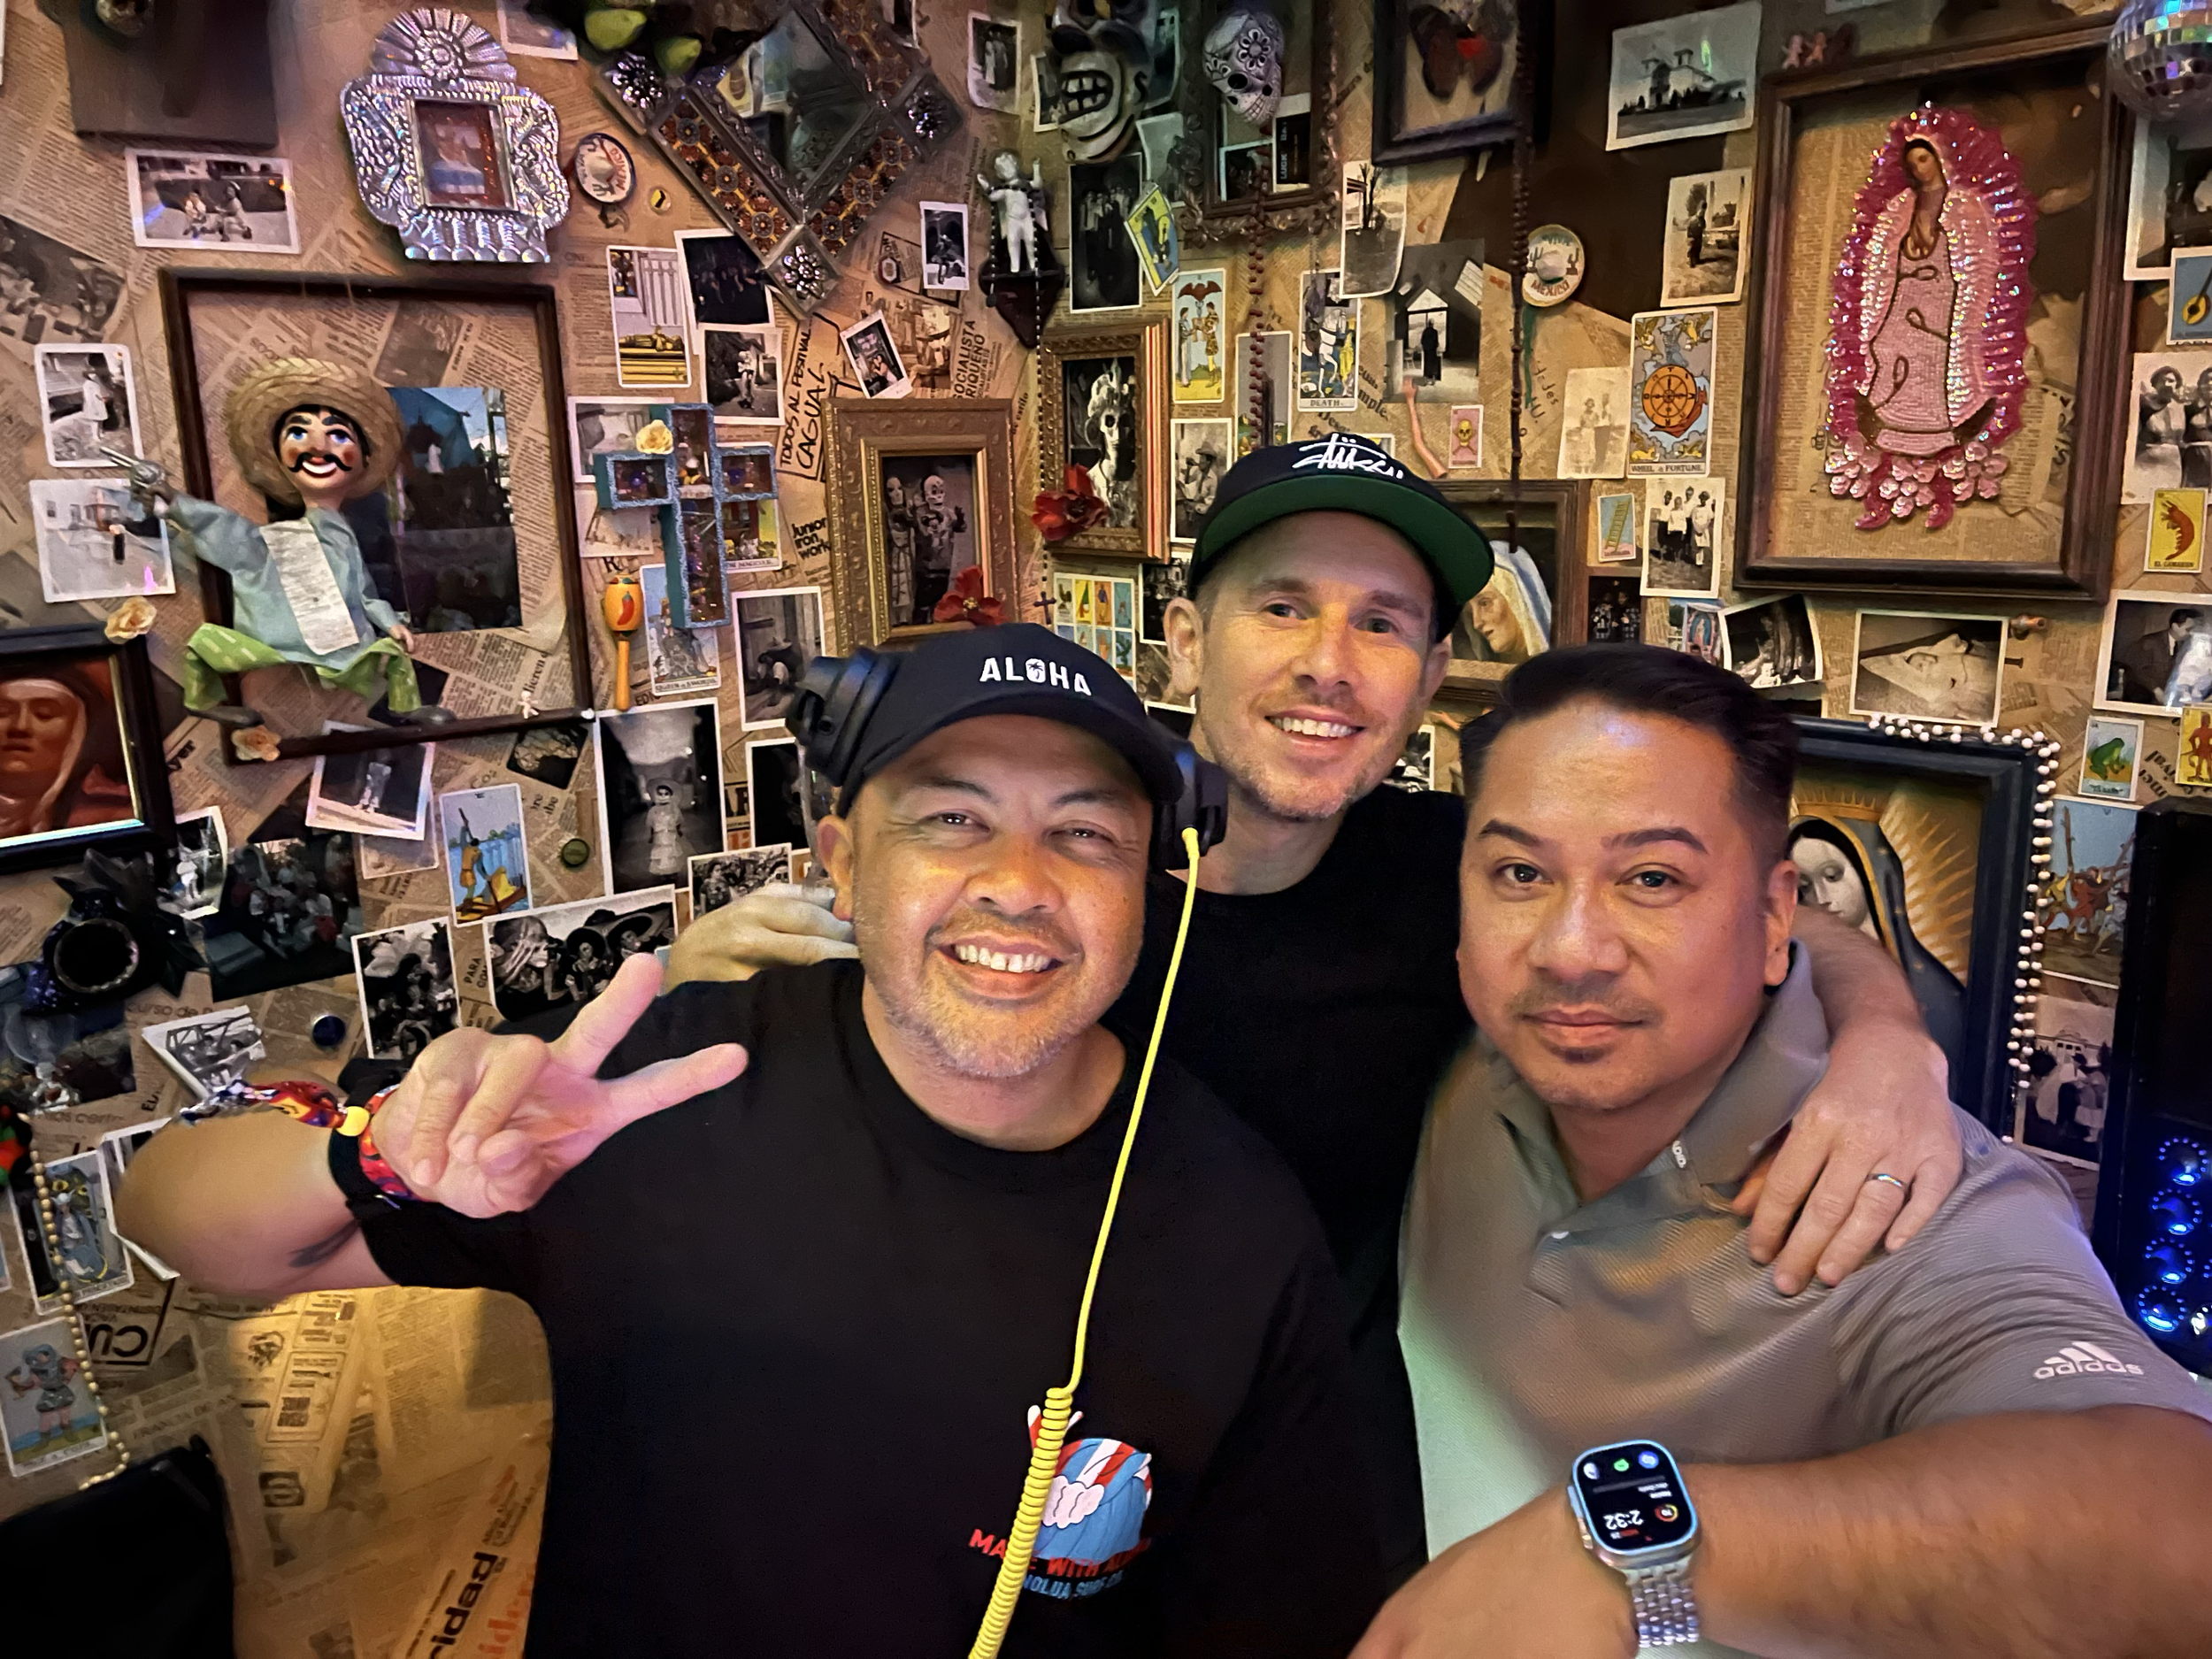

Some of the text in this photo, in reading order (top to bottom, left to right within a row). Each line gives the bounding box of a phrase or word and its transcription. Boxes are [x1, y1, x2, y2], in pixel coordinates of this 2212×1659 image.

[1530, 279, 1570, 297] MEXICO
[979, 657, 1092, 696] ALOHA
[463, 957, 482, 984] PARA
[2033, 1361, 2144, 1379] adidas
[1602, 1509, 1645, 1530] 2:32
